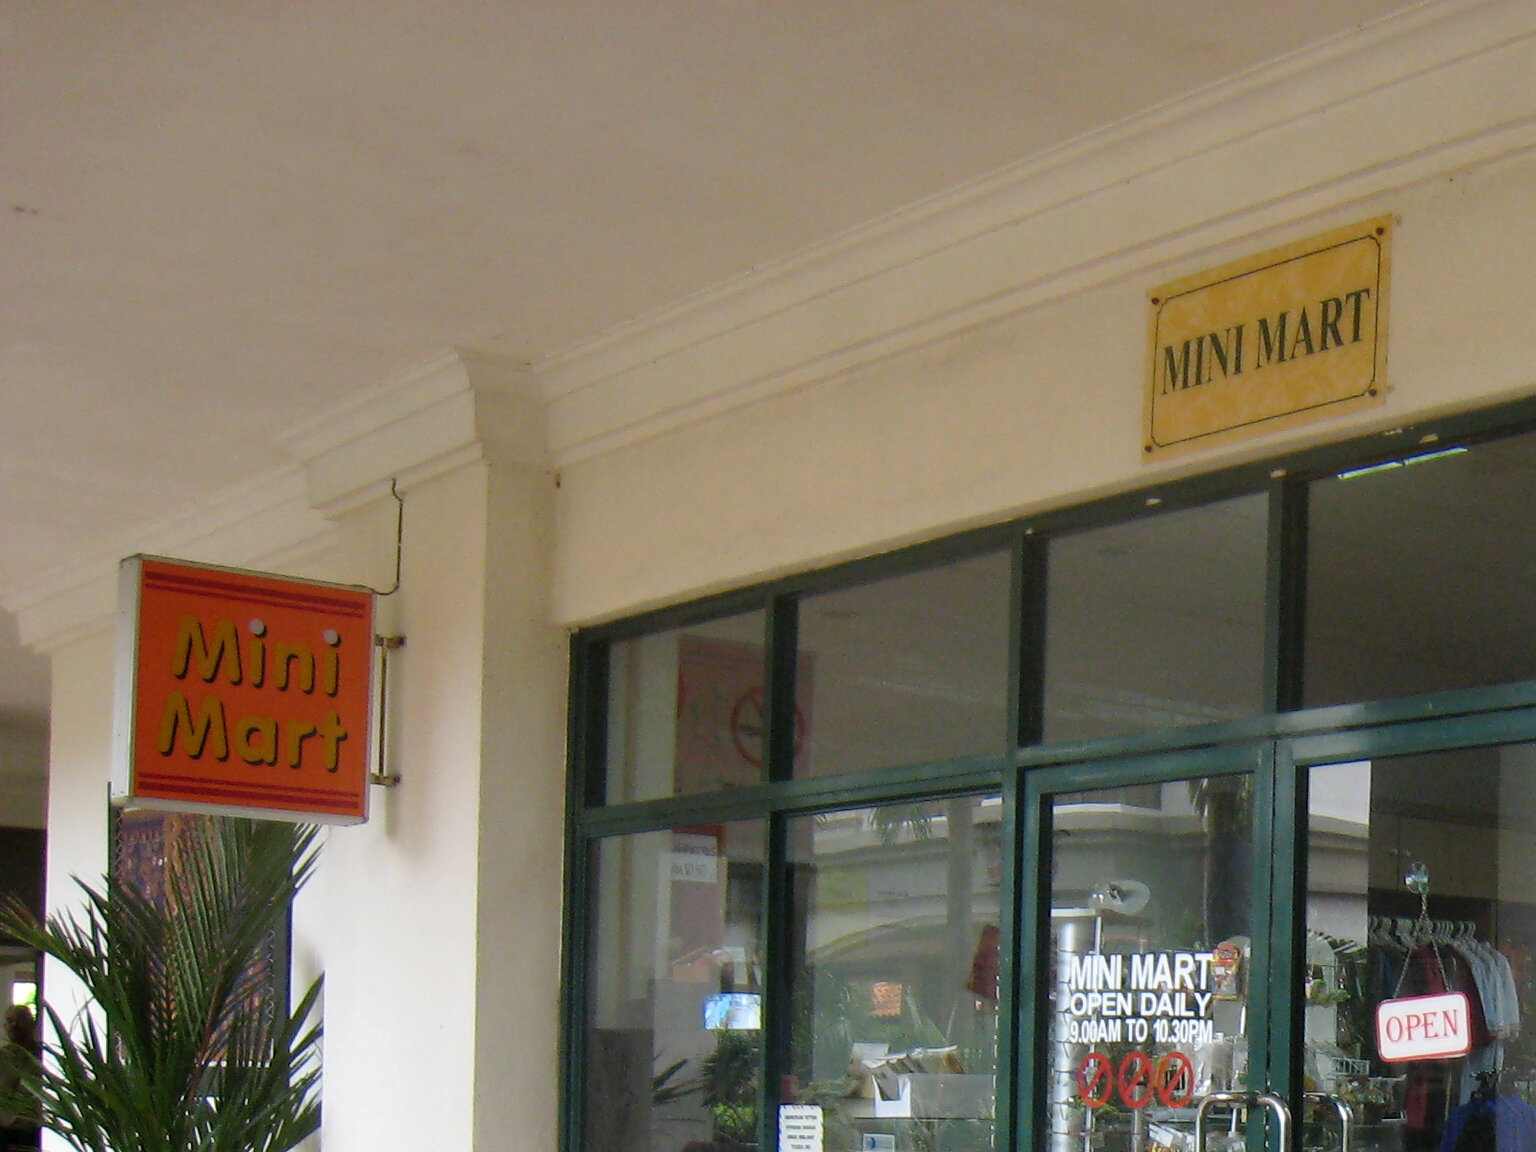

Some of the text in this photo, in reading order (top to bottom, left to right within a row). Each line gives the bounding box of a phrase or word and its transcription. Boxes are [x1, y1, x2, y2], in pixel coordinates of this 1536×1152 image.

[1161, 287, 1371, 395] MINI MART
[172, 614, 342, 697] Mini
[158, 690, 348, 773] Mart
[1071, 952, 1214, 991] MINI MART
[1070, 991, 1213, 1017] OPEN DAILY
[1070, 1018, 1213, 1044] 9.00AM TO 10.30PM
[1385, 1008, 1459, 1043] OPEN
